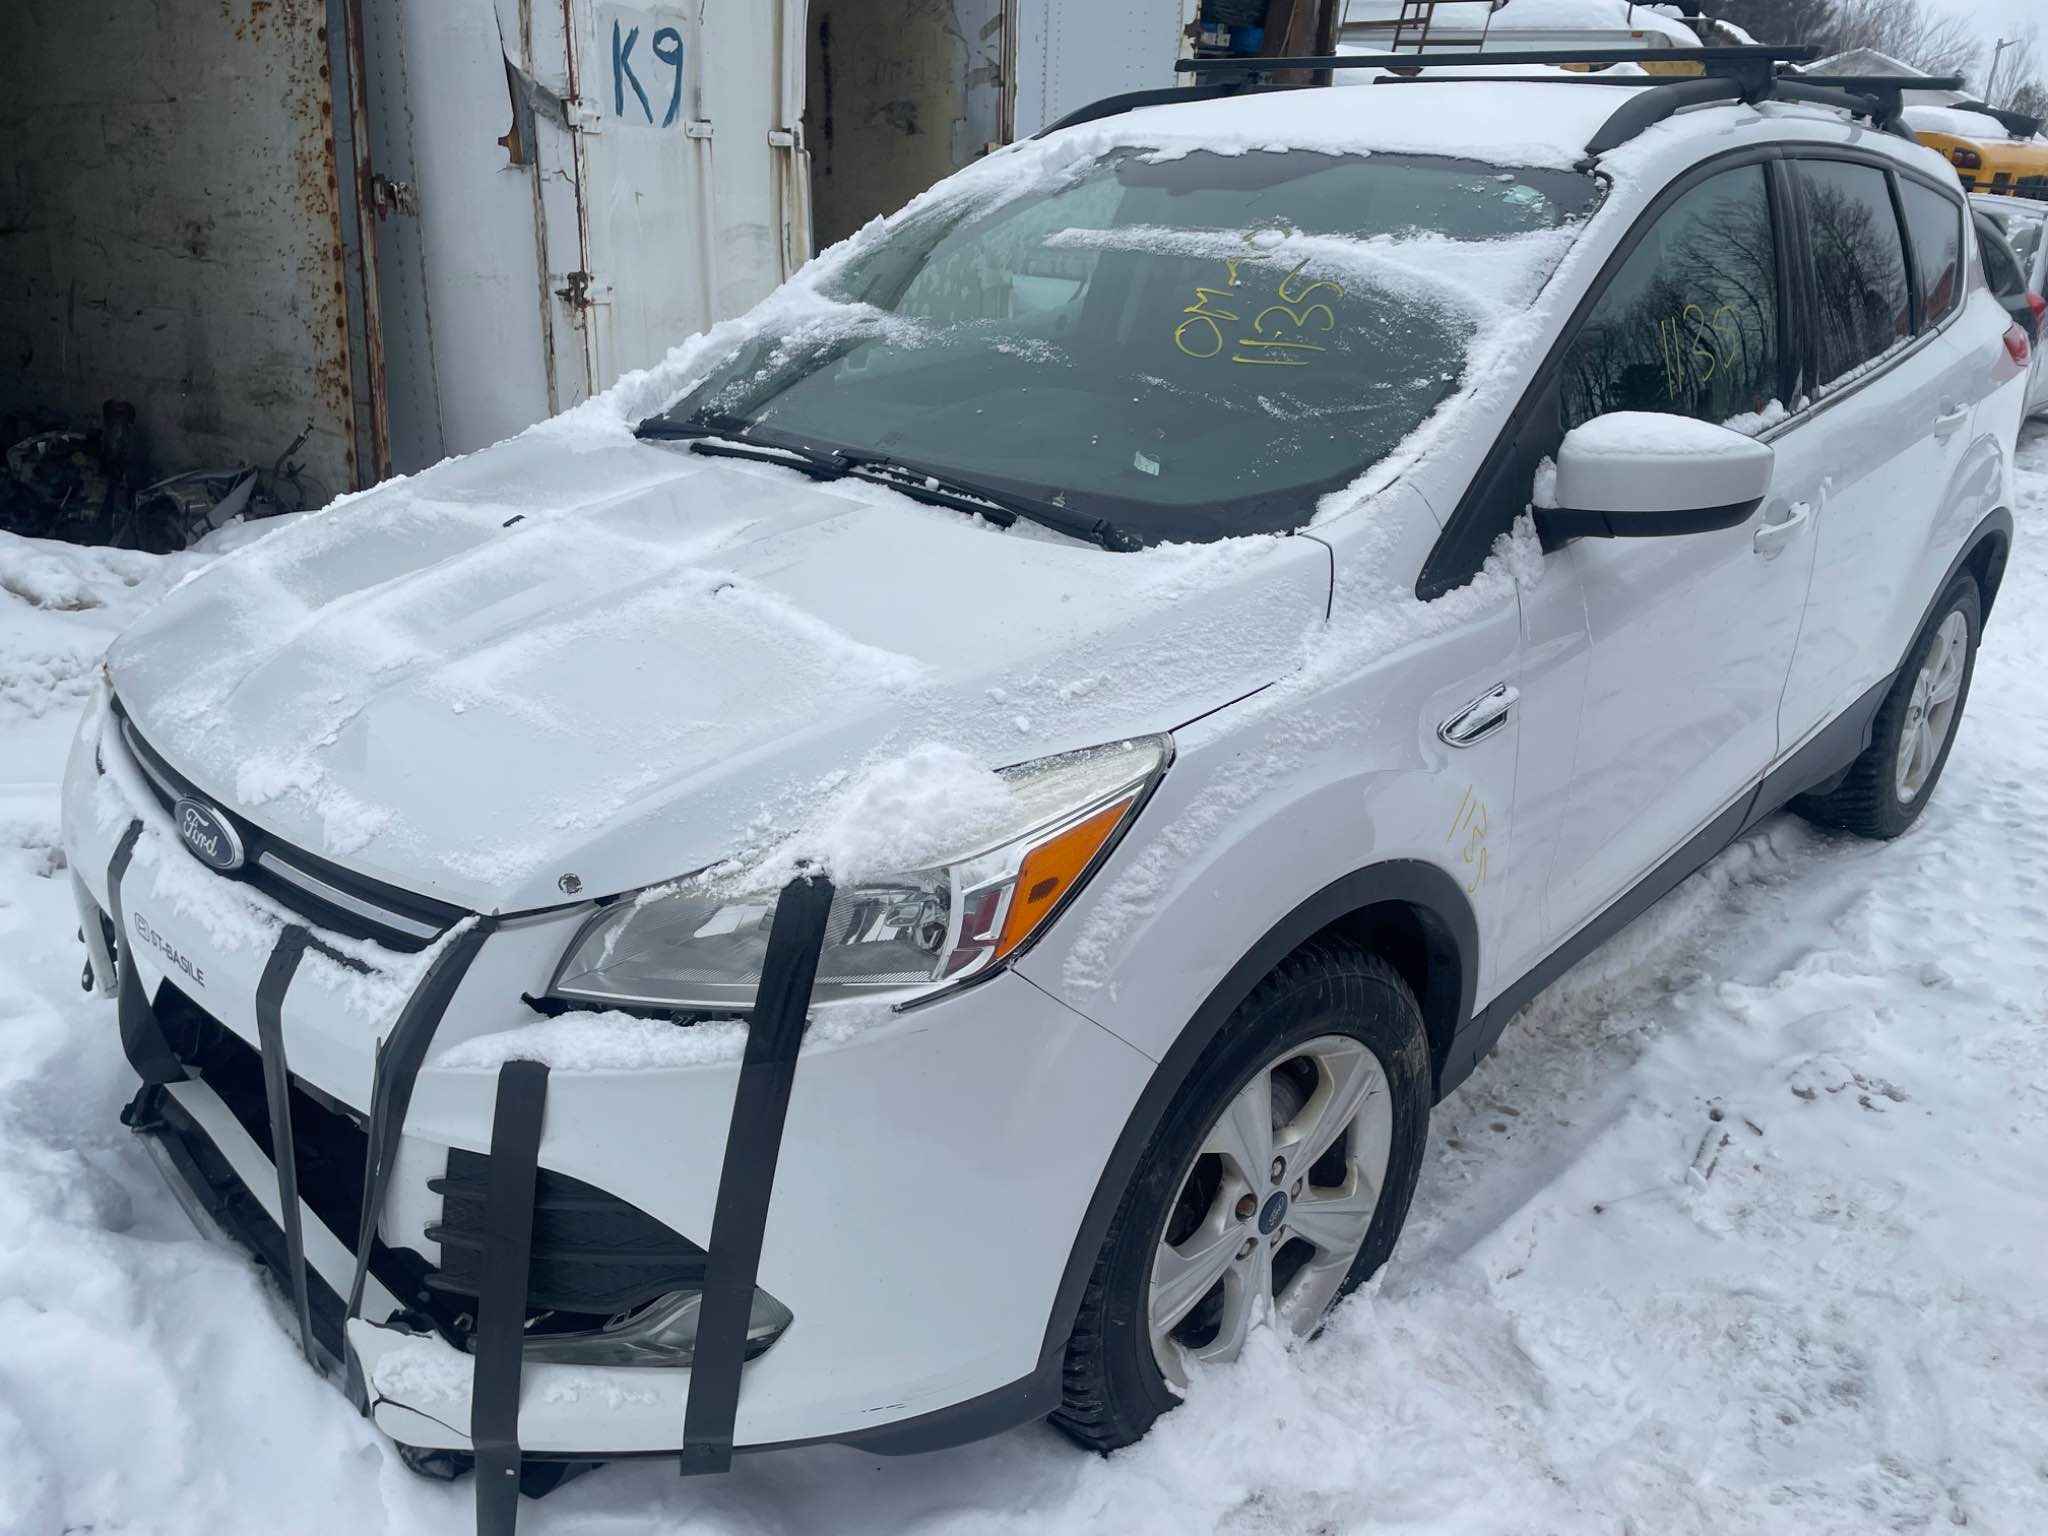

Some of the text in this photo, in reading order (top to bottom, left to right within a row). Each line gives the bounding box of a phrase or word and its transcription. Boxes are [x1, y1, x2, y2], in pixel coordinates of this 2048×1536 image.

[612, 18, 683, 128] K9
[183, 807, 219, 857] Ford
[150, 929, 206, 988] ST-BASILE
